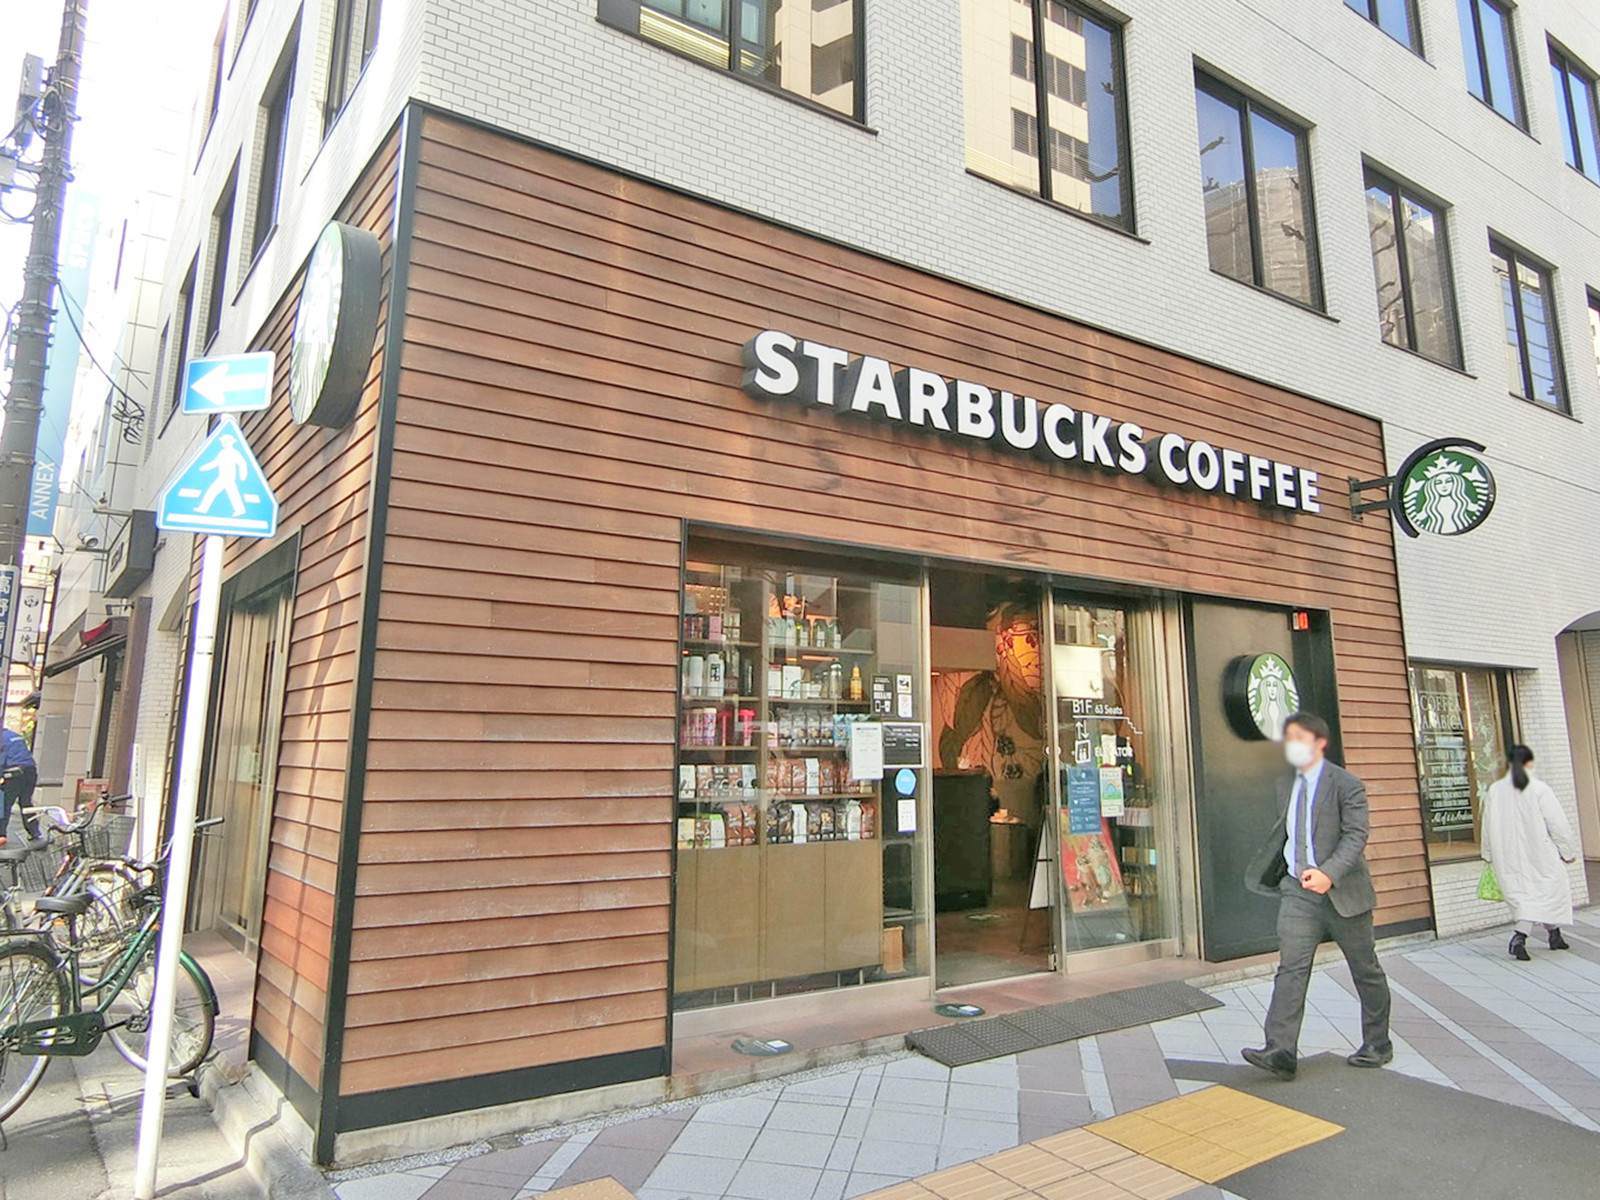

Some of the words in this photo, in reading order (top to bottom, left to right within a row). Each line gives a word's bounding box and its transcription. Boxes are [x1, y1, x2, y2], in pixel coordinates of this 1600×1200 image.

[753, 329, 1148, 475] STARBUCKS
[1158, 432, 1321, 513] COFFEE
[30, 460, 56, 520] ANNEX
[1072, 699, 1092, 713] B1F
[1104, 704, 1123, 715] Seats
